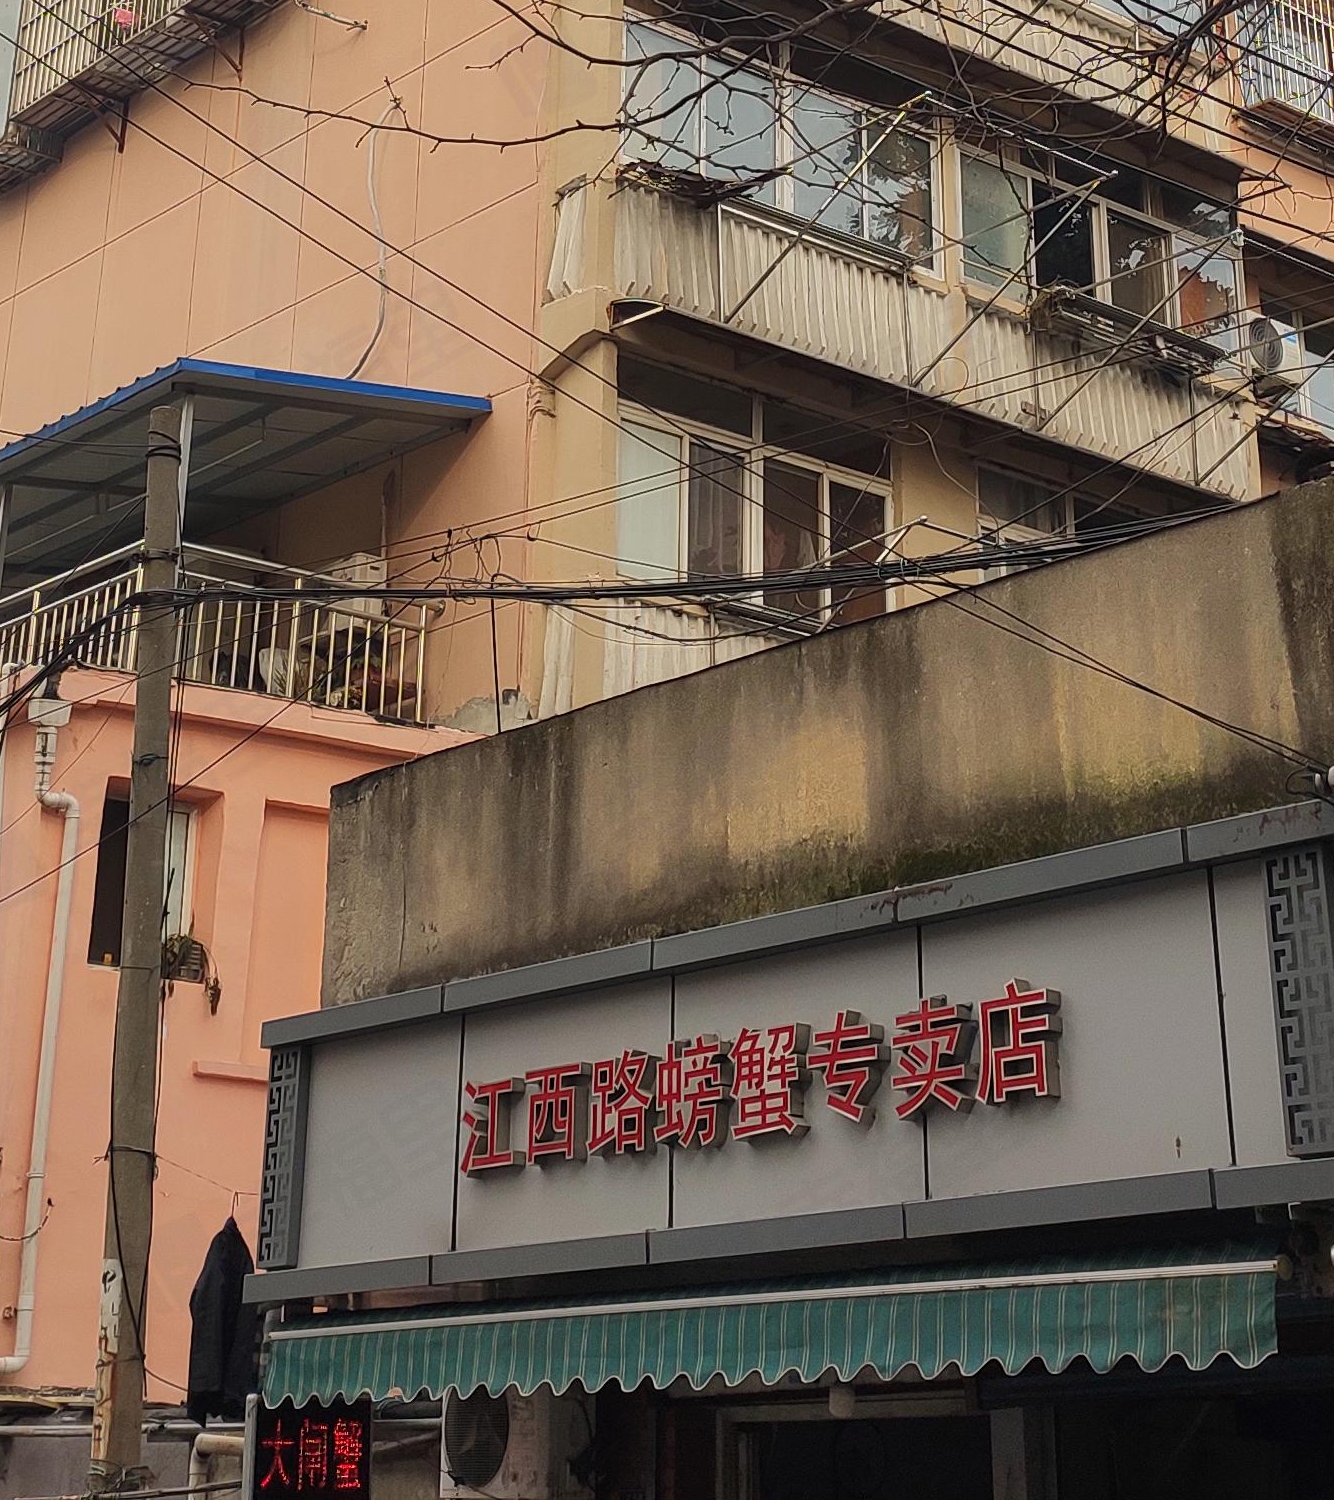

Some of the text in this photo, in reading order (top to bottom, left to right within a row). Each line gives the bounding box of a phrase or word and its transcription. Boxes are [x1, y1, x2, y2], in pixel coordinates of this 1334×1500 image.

[461, 978, 1061, 1177] 江西路螃蟹专卖店
[259, 1417, 364, 1491] 大闸蟹
